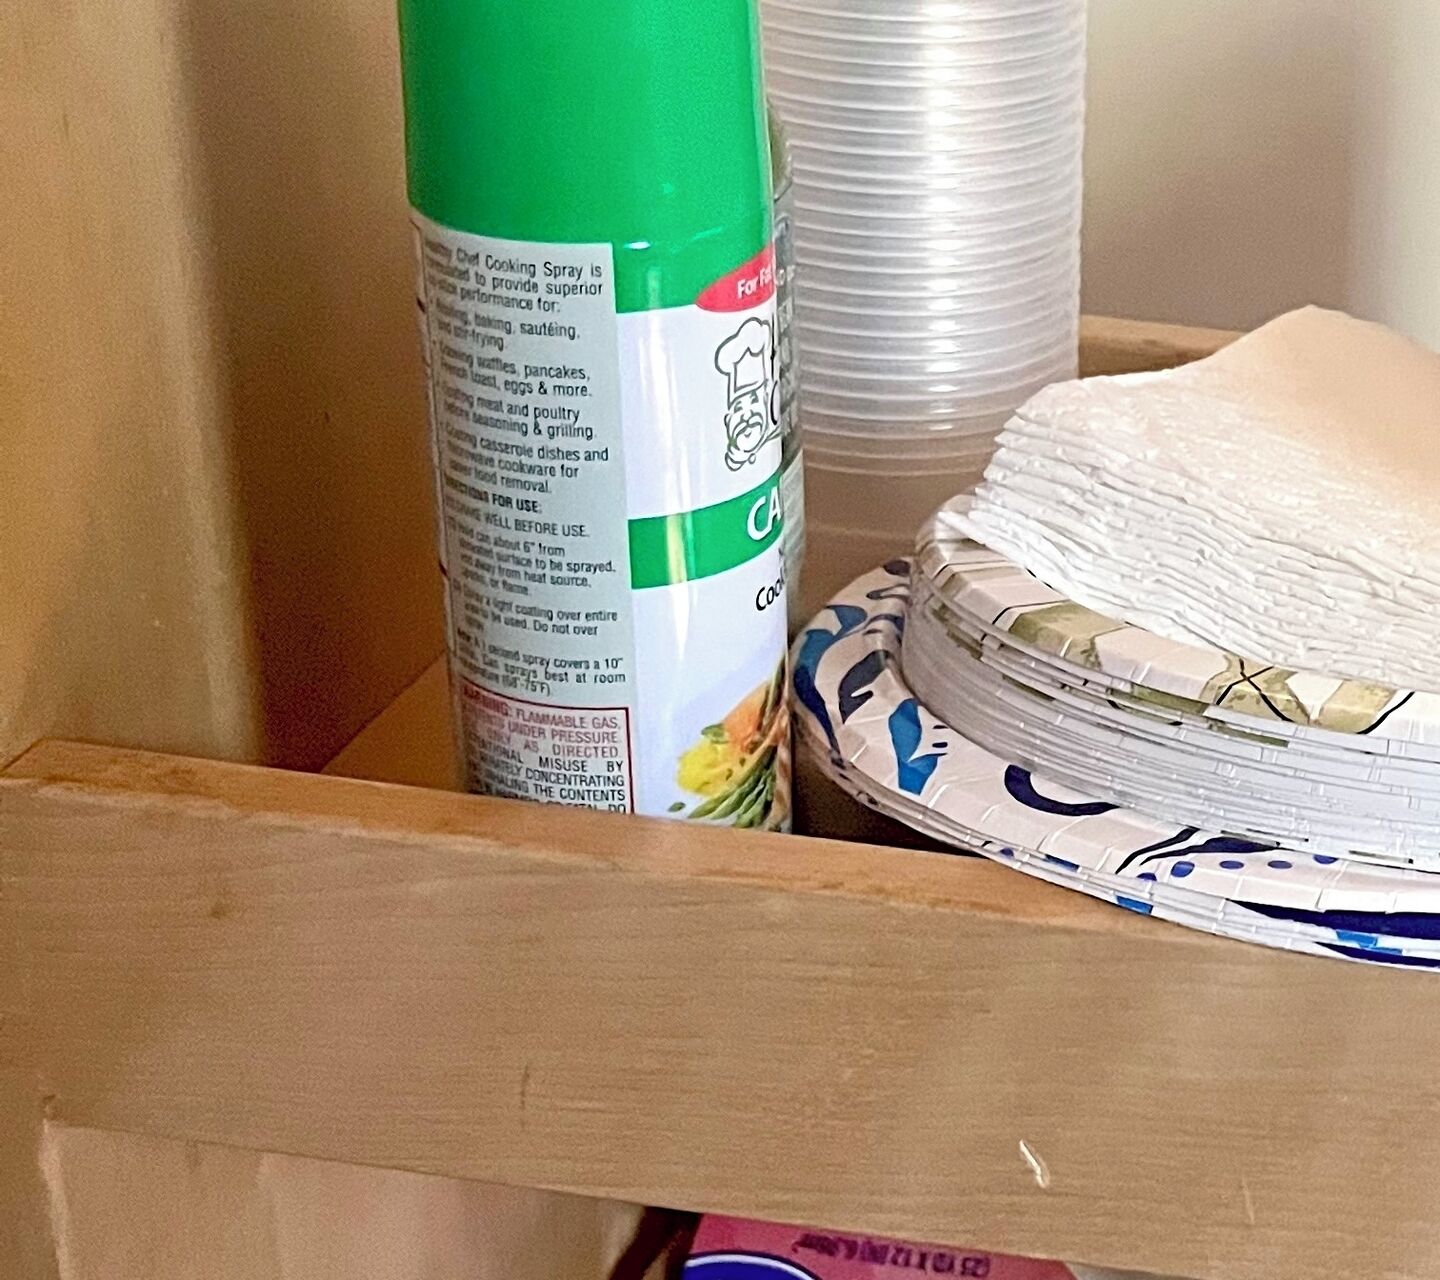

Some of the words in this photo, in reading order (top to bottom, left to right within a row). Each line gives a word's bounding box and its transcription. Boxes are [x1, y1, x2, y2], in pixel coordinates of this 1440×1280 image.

[485, 254, 537, 279] Cooking
[543, 261, 583, 282] Spray
[590, 263, 602, 278] is
[475, 271, 487, 288] to
[492, 276, 539, 295] provide
[545, 281, 603, 298] superior
[460, 285, 534, 312] performance
[537, 296, 561, 313] for:
[524, 364, 590, 382] pancakes,
[504, 377, 534, 397] eggs
[538, 381, 548, 395] &
[553, 382, 593, 397] more.
[507, 401, 529, 418] and
[533, 406, 580, 425] poultry
[533, 422, 543, 436] &
[547, 422, 597, 442] grilling.
[480, 436, 534, 458] casserole
[537, 445, 580, 462] dishes
[584, 446, 609, 462] and
[498, 456, 556, 477] cookware
[560, 463, 580, 478] for
[500, 474, 552, 494] removal.
[492, 491, 514, 511] FOR
[516, 499, 542, 514] USE:
[514, 518, 559, 536] BEFORE
[562, 523, 590, 538] USE.
[538, 542, 566, 558] from
[535, 557, 547, 571] to
[550, 559, 563, 572] be
[566, 560, 616, 574] sprayed.
[524, 570, 547, 586] heat
[550, 574, 592, 589] source,
[557, 609, 582, 621] over
[585, 609, 618, 622] entire
[533, 619, 549, 633] Do
[552, 620, 570, 634] not
[573, 625, 598, 637] over
[553, 657, 590, 670] covers
[593, 659, 601, 670] a
[544, 667, 570, 685] best
[575, 671, 587, 685] at
[593, 672, 626, 685] room
[516, 707, 588, 729] FLAMMABLE
[508, 720, 547, 738] UNDER
[523, 739, 540, 754] AS
[538, 756, 588, 772] MISUSE
[607, 761, 624, 772] BY
[526, 767, 625, 787] CONCENTRATING
[533, 783, 555, 799] THE
[559, 788, 627, 802] CONTENTS
